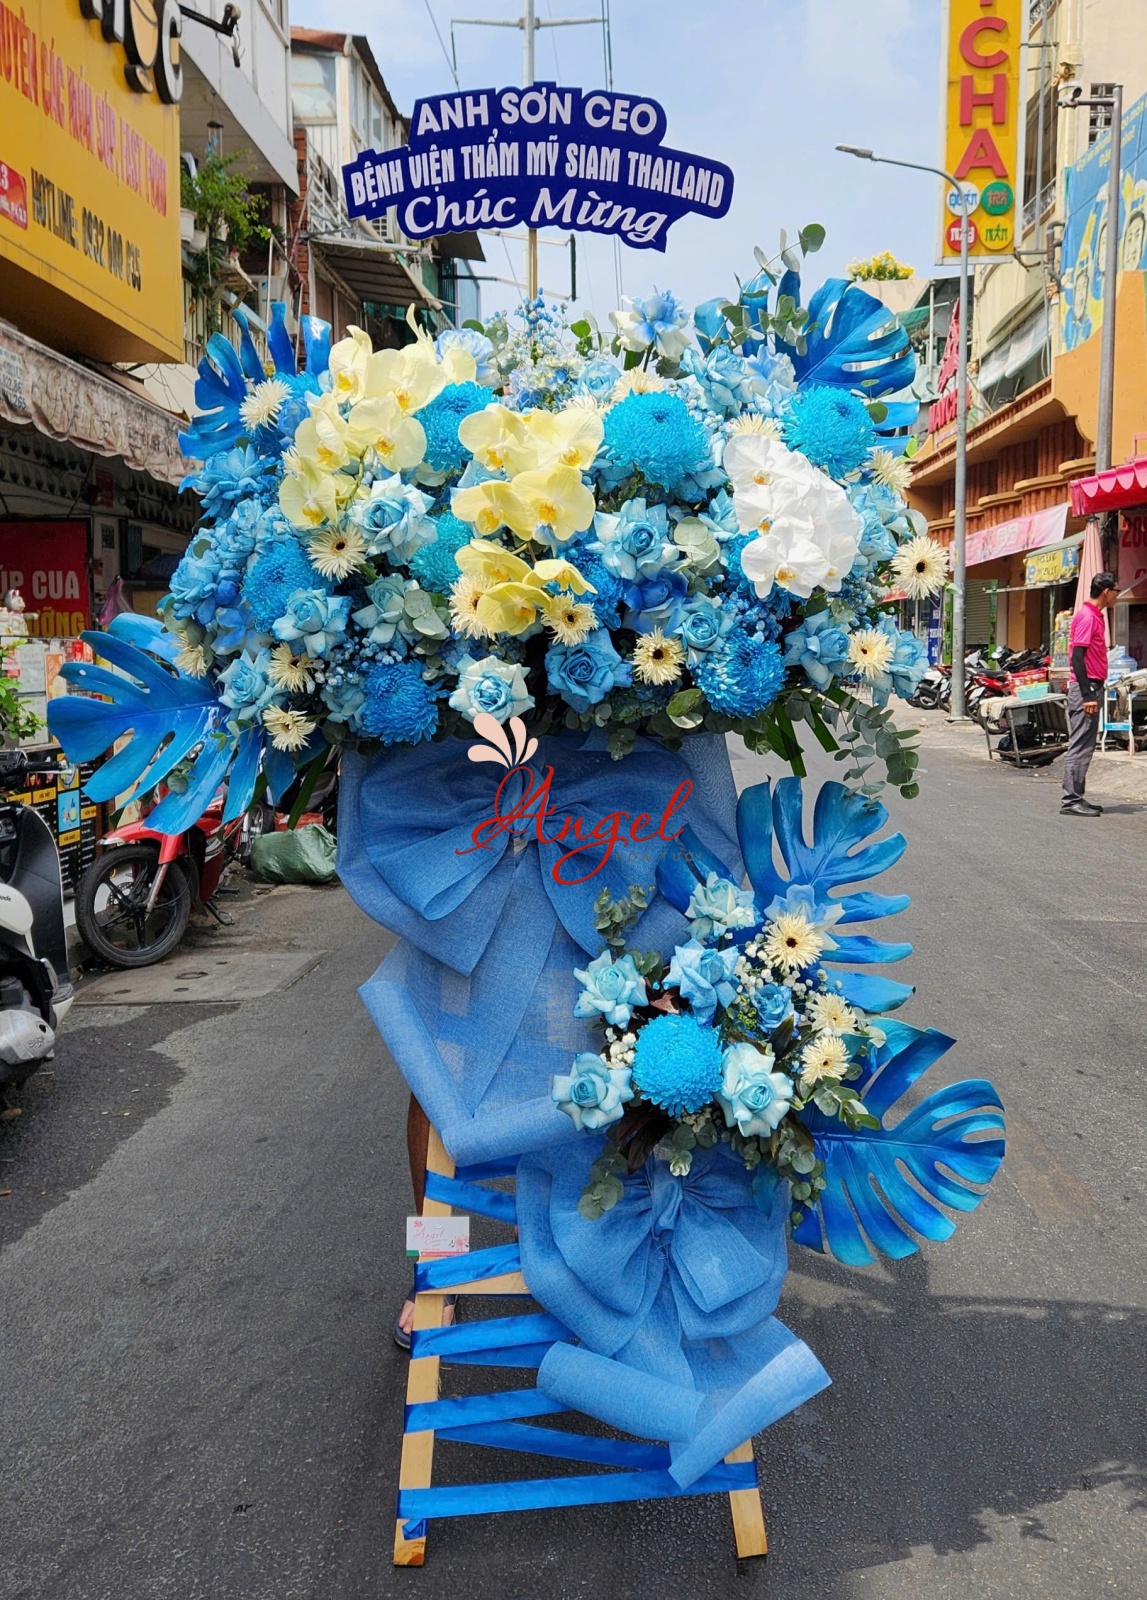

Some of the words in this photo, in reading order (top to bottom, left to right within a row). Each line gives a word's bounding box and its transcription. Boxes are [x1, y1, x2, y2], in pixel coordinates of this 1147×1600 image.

[0, 2, 38, 107] UYÊN
[417, 95, 489, 136] ANH
[501, 87, 571, 125] SƠN
[585, 95, 658, 135] CEO
[954, 0, 1009, 178] CHA
[350, 156, 403, 209] BỆNH
[409, 145, 455, 193] VIỆN
[461, 128, 519, 181] THẨM
[527, 135, 558, 177] MỸ
[565, 143, 619, 182] SIAM
[627, 151, 725, 208] THAILAND
[405, 188, 517, 233] Chúc
[531, 188, 668, 243] Mừng
[32, 570, 80, 600] CUA
